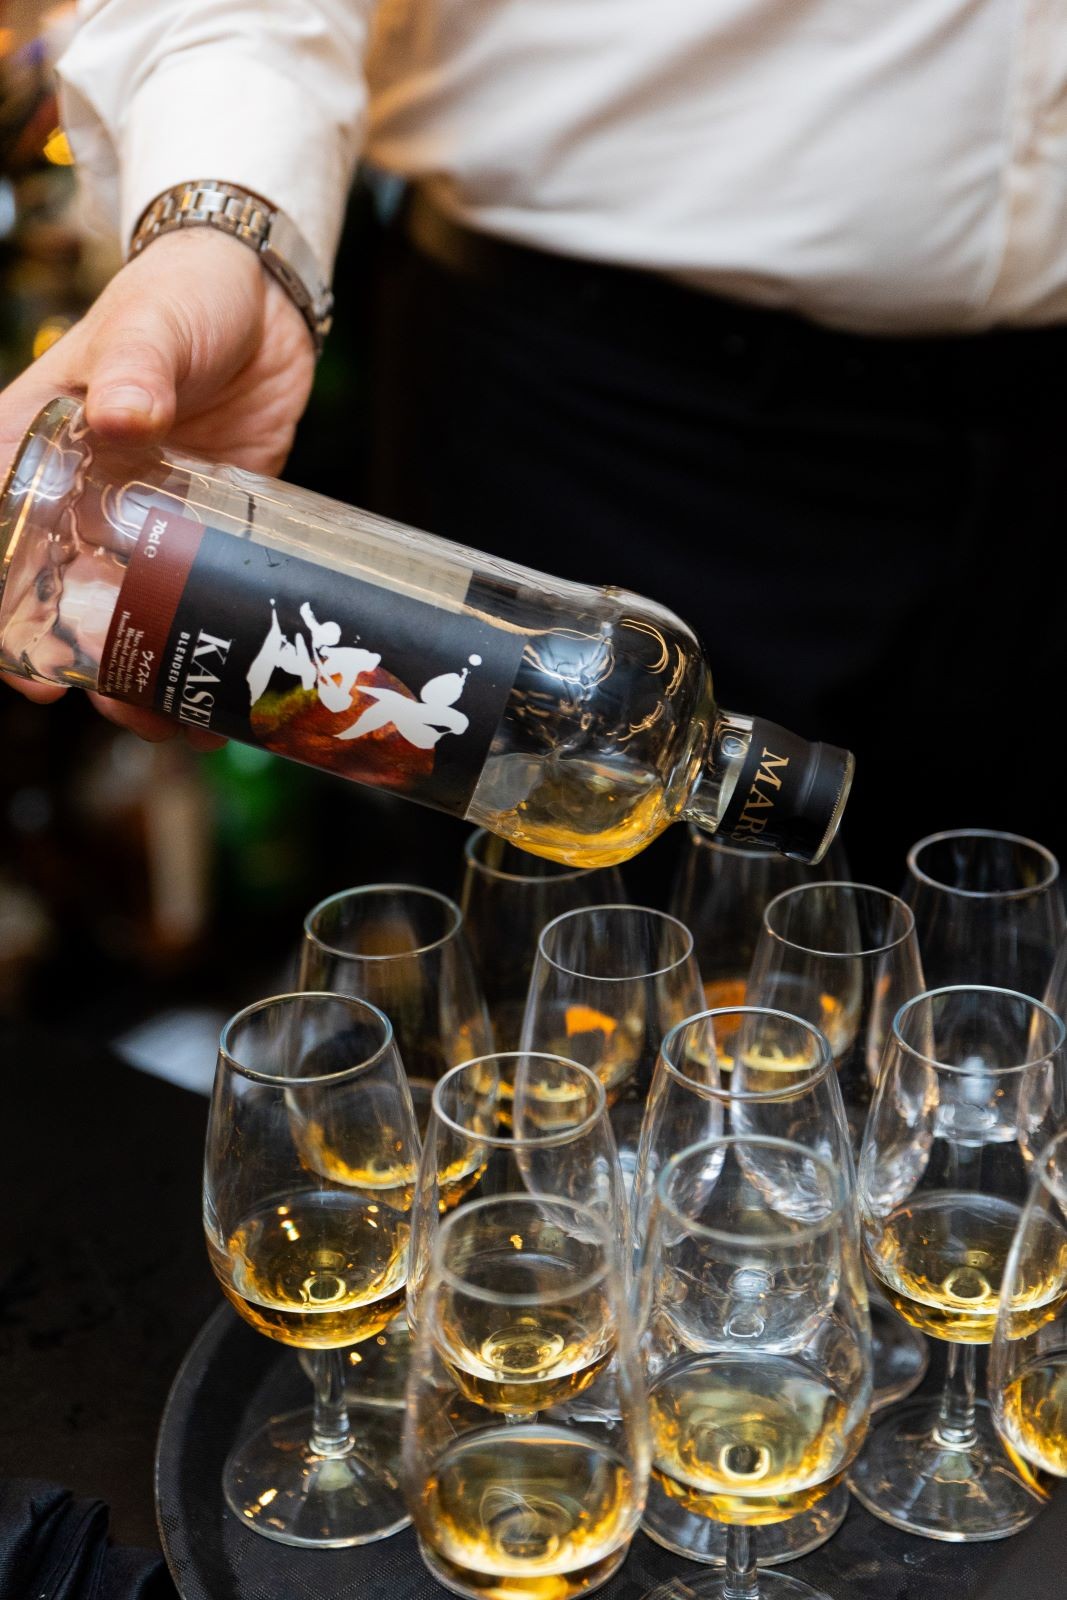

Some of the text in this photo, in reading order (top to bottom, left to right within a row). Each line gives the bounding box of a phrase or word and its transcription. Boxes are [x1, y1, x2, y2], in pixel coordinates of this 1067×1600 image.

[148, 518, 168, 545] 70cl
[136, 650, 155, 693] ウイスキー
[168, 631, 191, 683] BLENDED
[179, 628, 232, 728] KASEI
[731, 746, 790, 847] MARS
